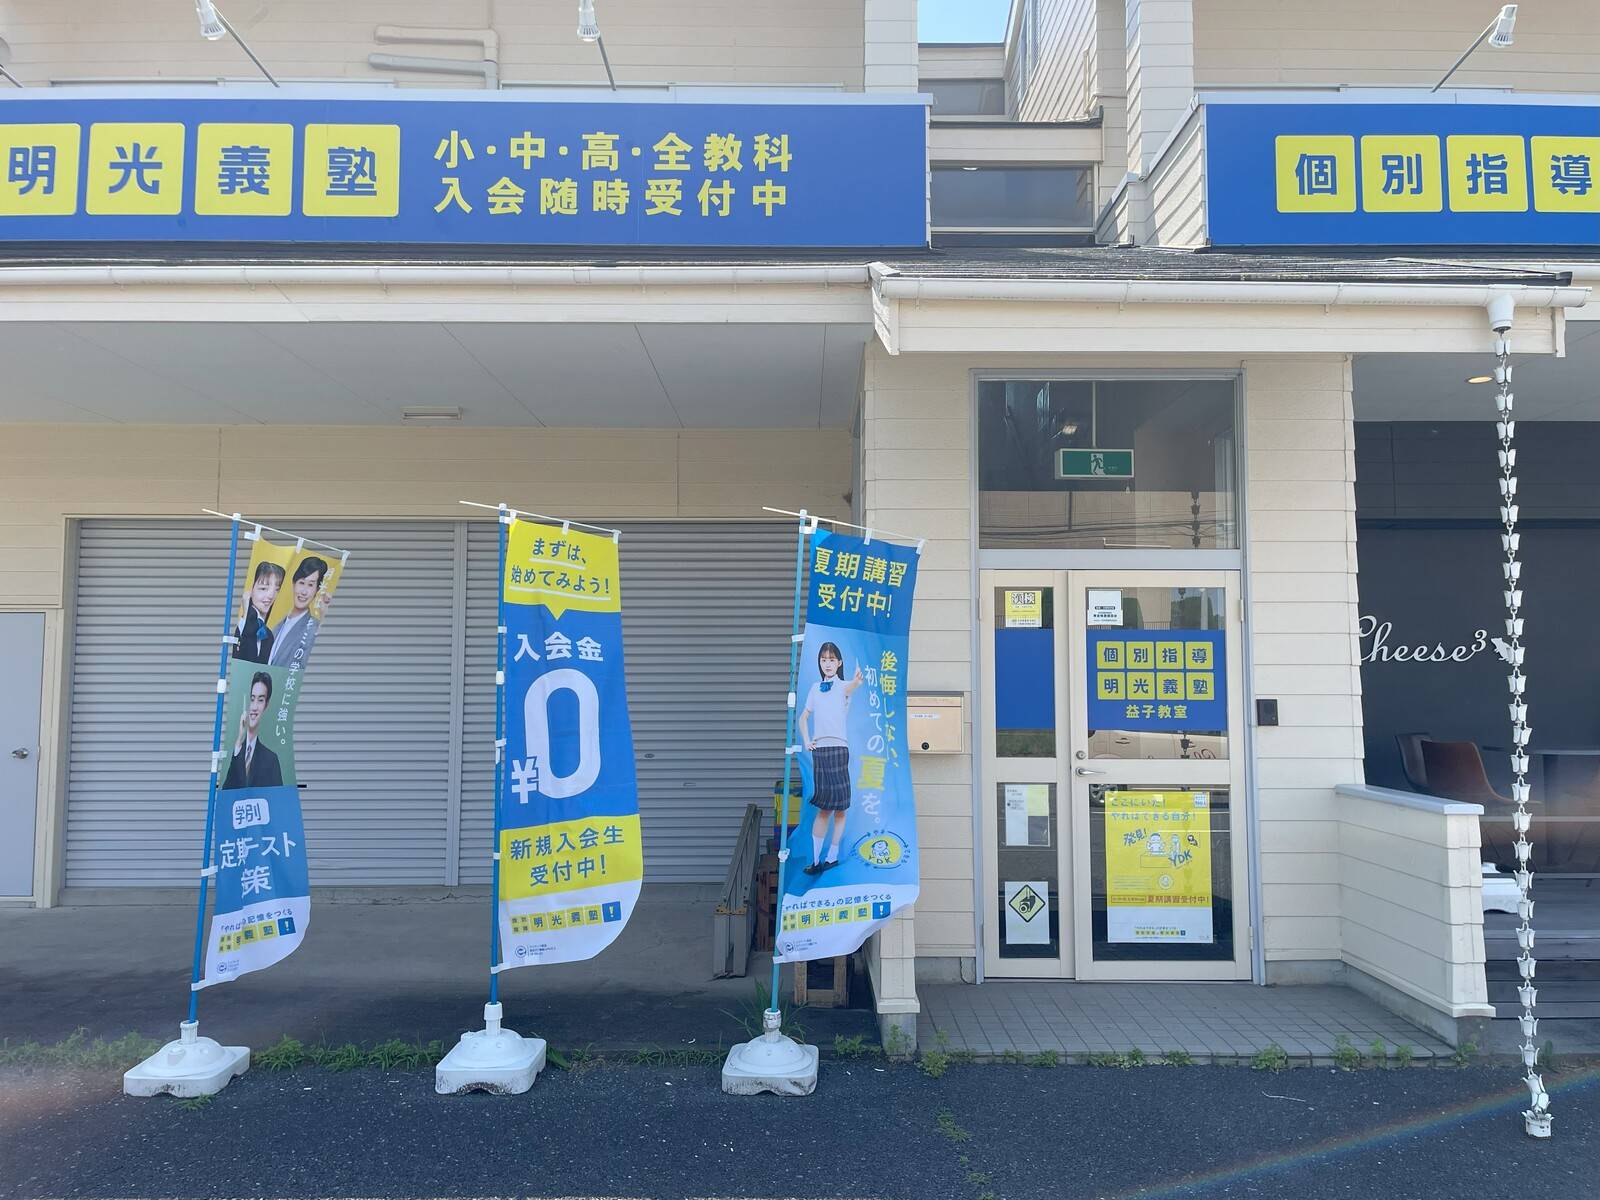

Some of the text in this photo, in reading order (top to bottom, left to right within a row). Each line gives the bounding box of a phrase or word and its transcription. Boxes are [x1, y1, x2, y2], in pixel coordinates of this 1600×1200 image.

[434, 130, 793, 173] 小・中・高・全教科
[9, 142, 377, 197] 明光義塾
[1295, 153, 1593, 196] 個別指導
[433, 177, 788, 217] 入会随時受付中
[511, 565, 609, 594] 始めてみよう!
[814, 546, 907, 588] 夏期講習
[818, 583, 892, 618] 受付中!
[513, 631, 604, 662] 入会金
[1104, 647, 1207, 664] 個別指導
[1104, 678, 1208, 695] 明光義塾
[1126, 704, 1188, 719] 益子教室
[511, 825, 624, 860] 新規入会生
[530, 854, 606, 887] 受付中!
